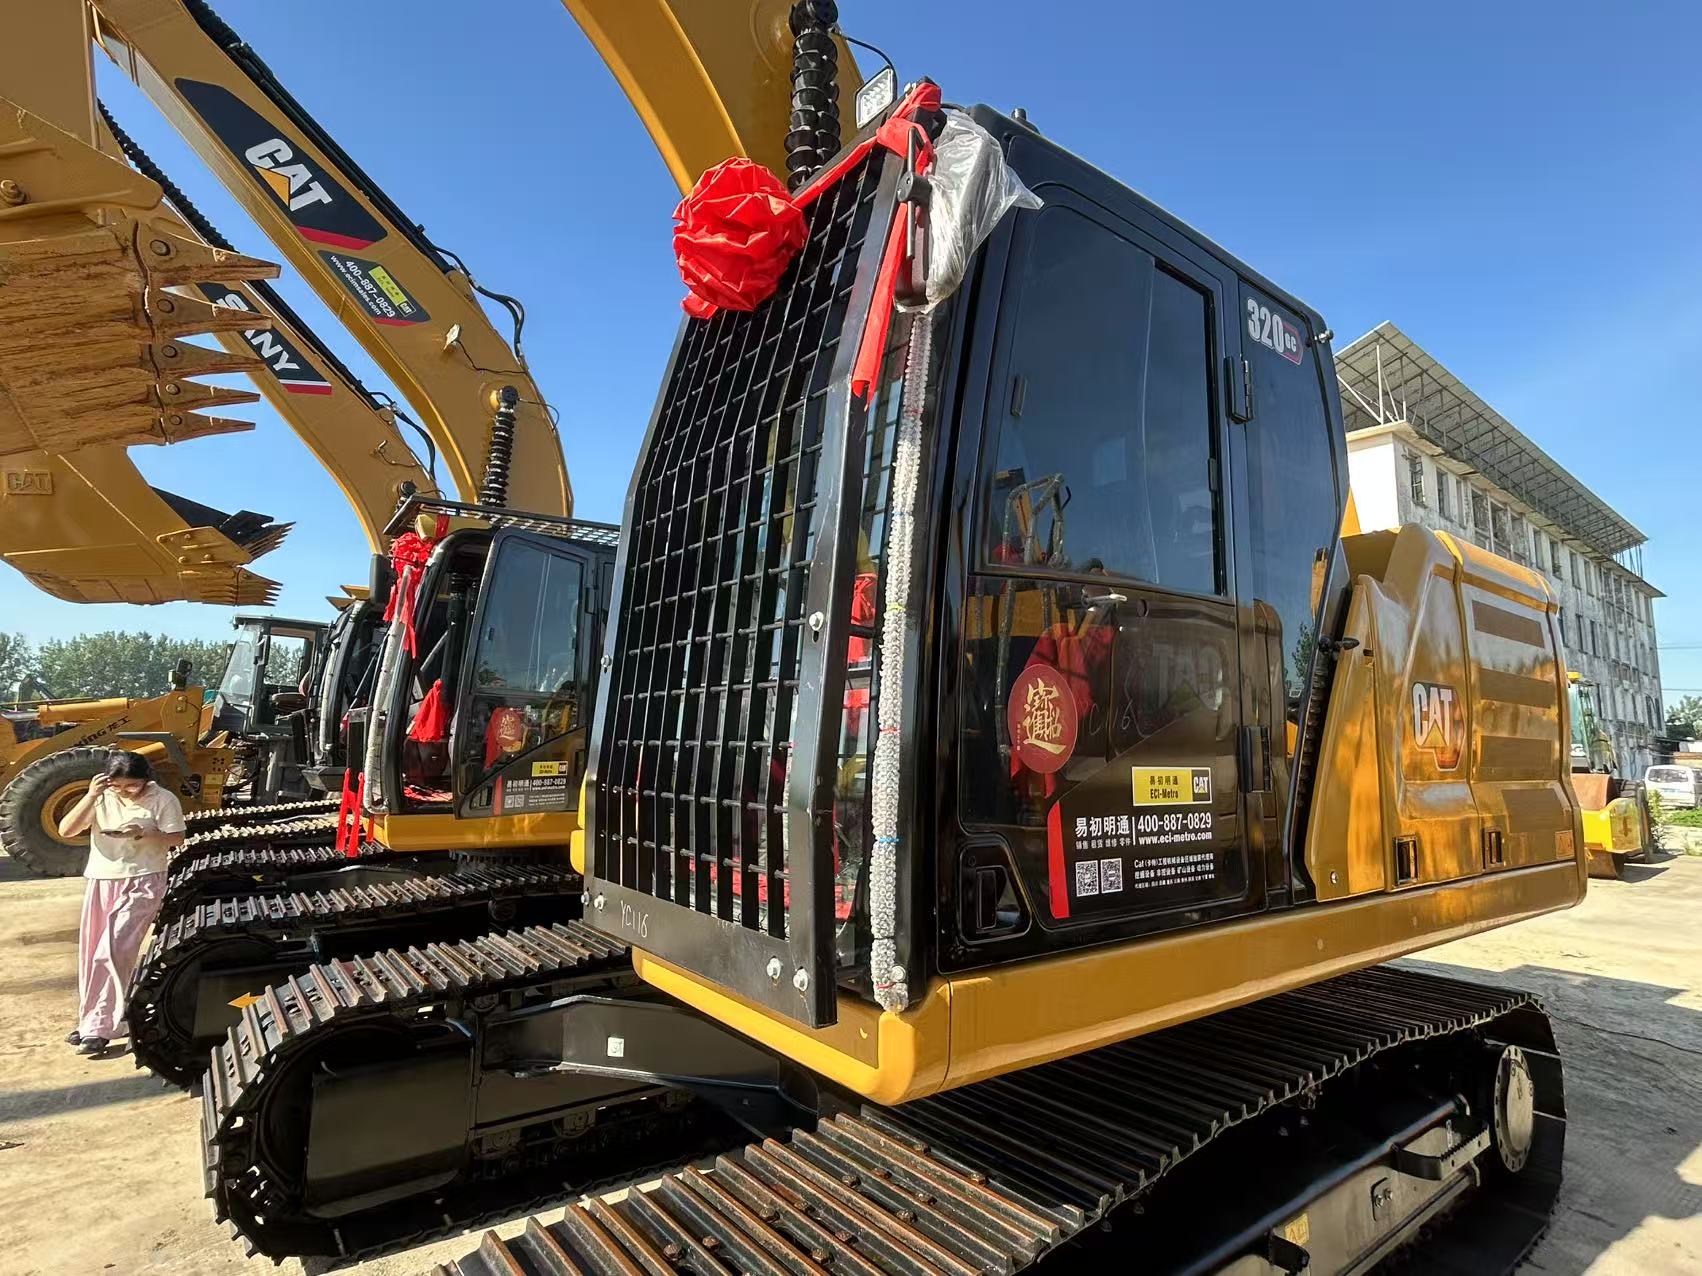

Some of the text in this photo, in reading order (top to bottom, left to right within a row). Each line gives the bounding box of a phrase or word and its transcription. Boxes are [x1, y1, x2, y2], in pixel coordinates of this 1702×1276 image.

[245, 138, 333, 212] CAT
[346, 260, 396, 318] 400-887-0829
[215, 293, 300, 371] SNY
[1247, 298, 1297, 353] 320 GC
[1412, 682, 1453, 747] CAT
[1193, 776, 1208, 794] CAT
[1075, 815, 1130, 838] 易初明通
[1138, 812, 1212, 833] 400-887-0829
[1138, 831, 1213, 846] www.eci-metro.com
[620, 900, 649, 938] YC116
